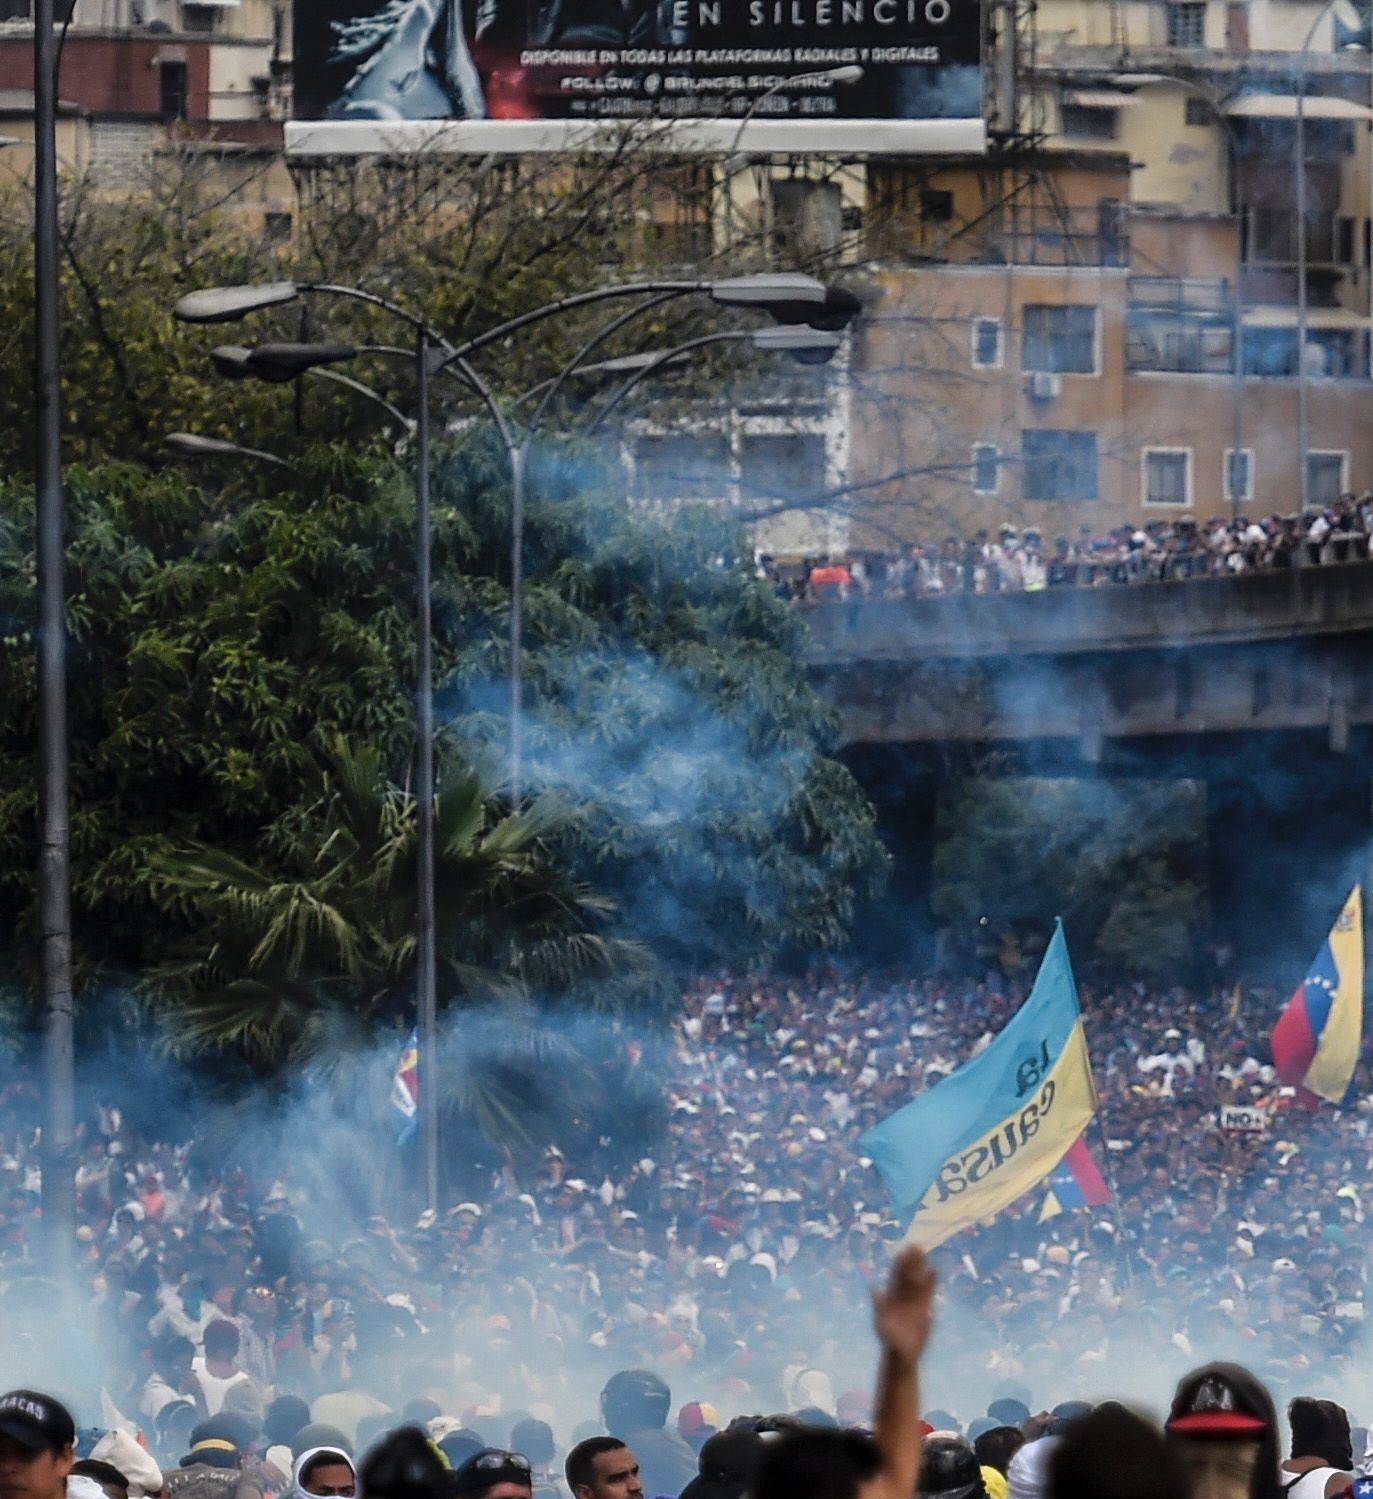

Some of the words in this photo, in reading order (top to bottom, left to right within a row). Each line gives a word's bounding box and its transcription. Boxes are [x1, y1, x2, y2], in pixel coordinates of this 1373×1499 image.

[672, 0, 721, 26] EN
[749, 0, 951, 26] SILENCIO
[520, 50, 597, 66] DISPONIBLE
[620, 50, 666, 65] TODAS
[668, 50, 693, 64] LAS
[694, 49, 792, 64] PLATAFORMAS
[794, 48, 857, 62] RADIALES
[872, 47, 940, 62] DIGITALES
